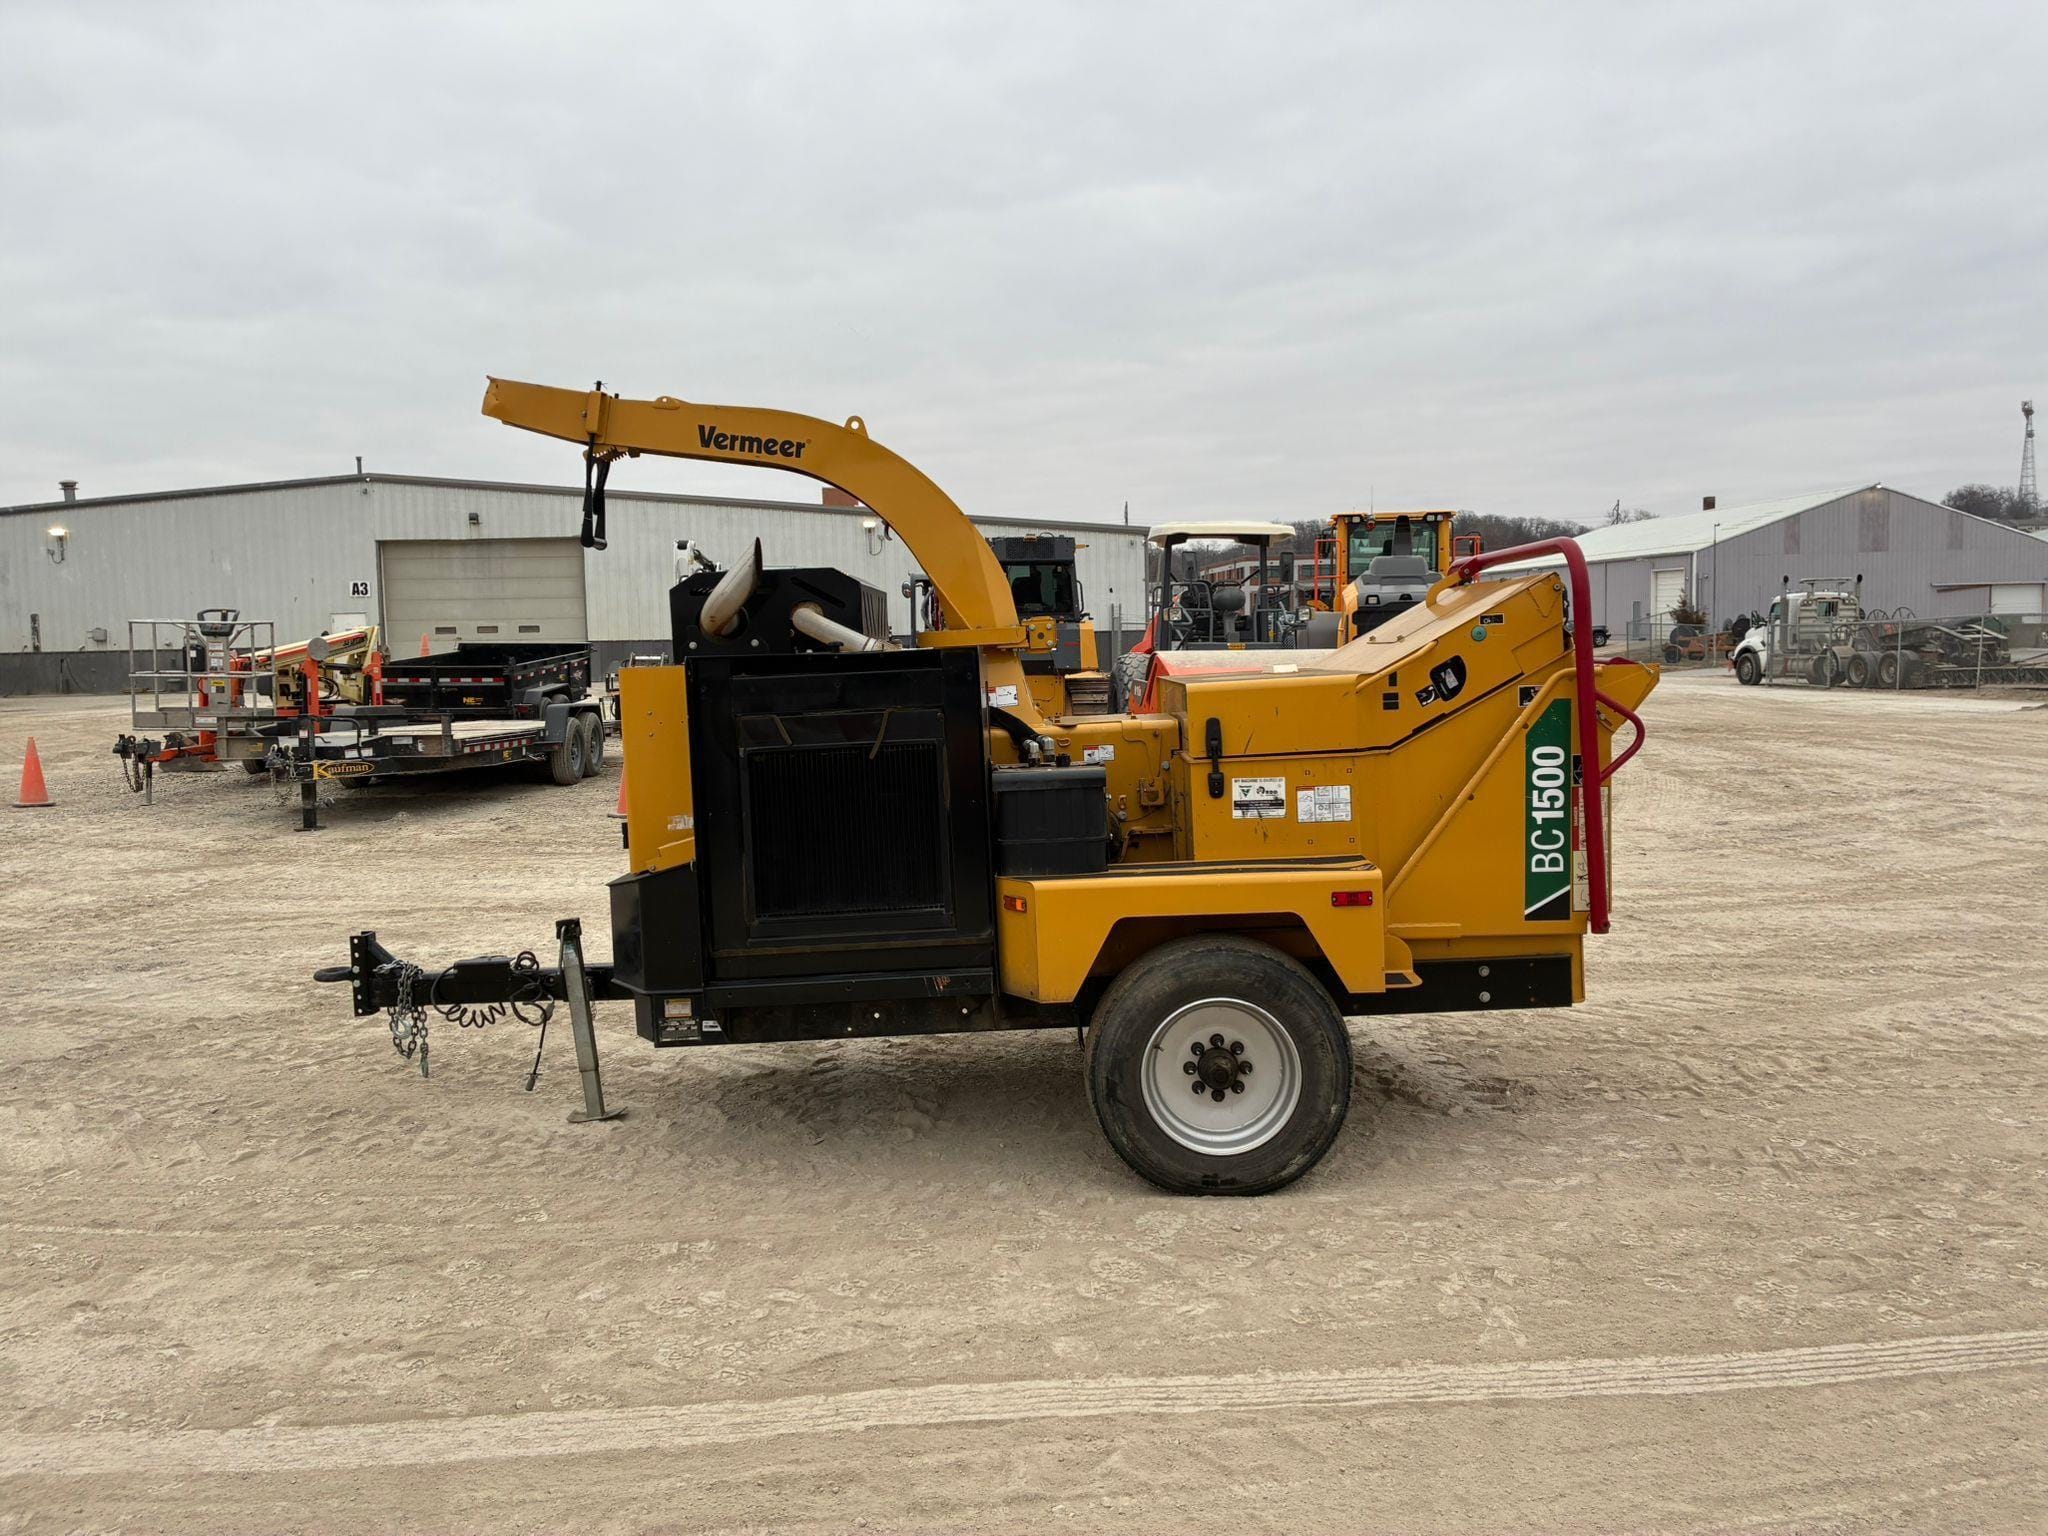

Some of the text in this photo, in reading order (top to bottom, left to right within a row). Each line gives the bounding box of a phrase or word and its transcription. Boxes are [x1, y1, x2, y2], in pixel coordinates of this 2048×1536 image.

[698, 424, 806, 458] Vermeer
[352, 582, 368, 595] A3
[312, 760, 369, 780] Kaufman
[1531, 746, 1565, 873] BC1500
